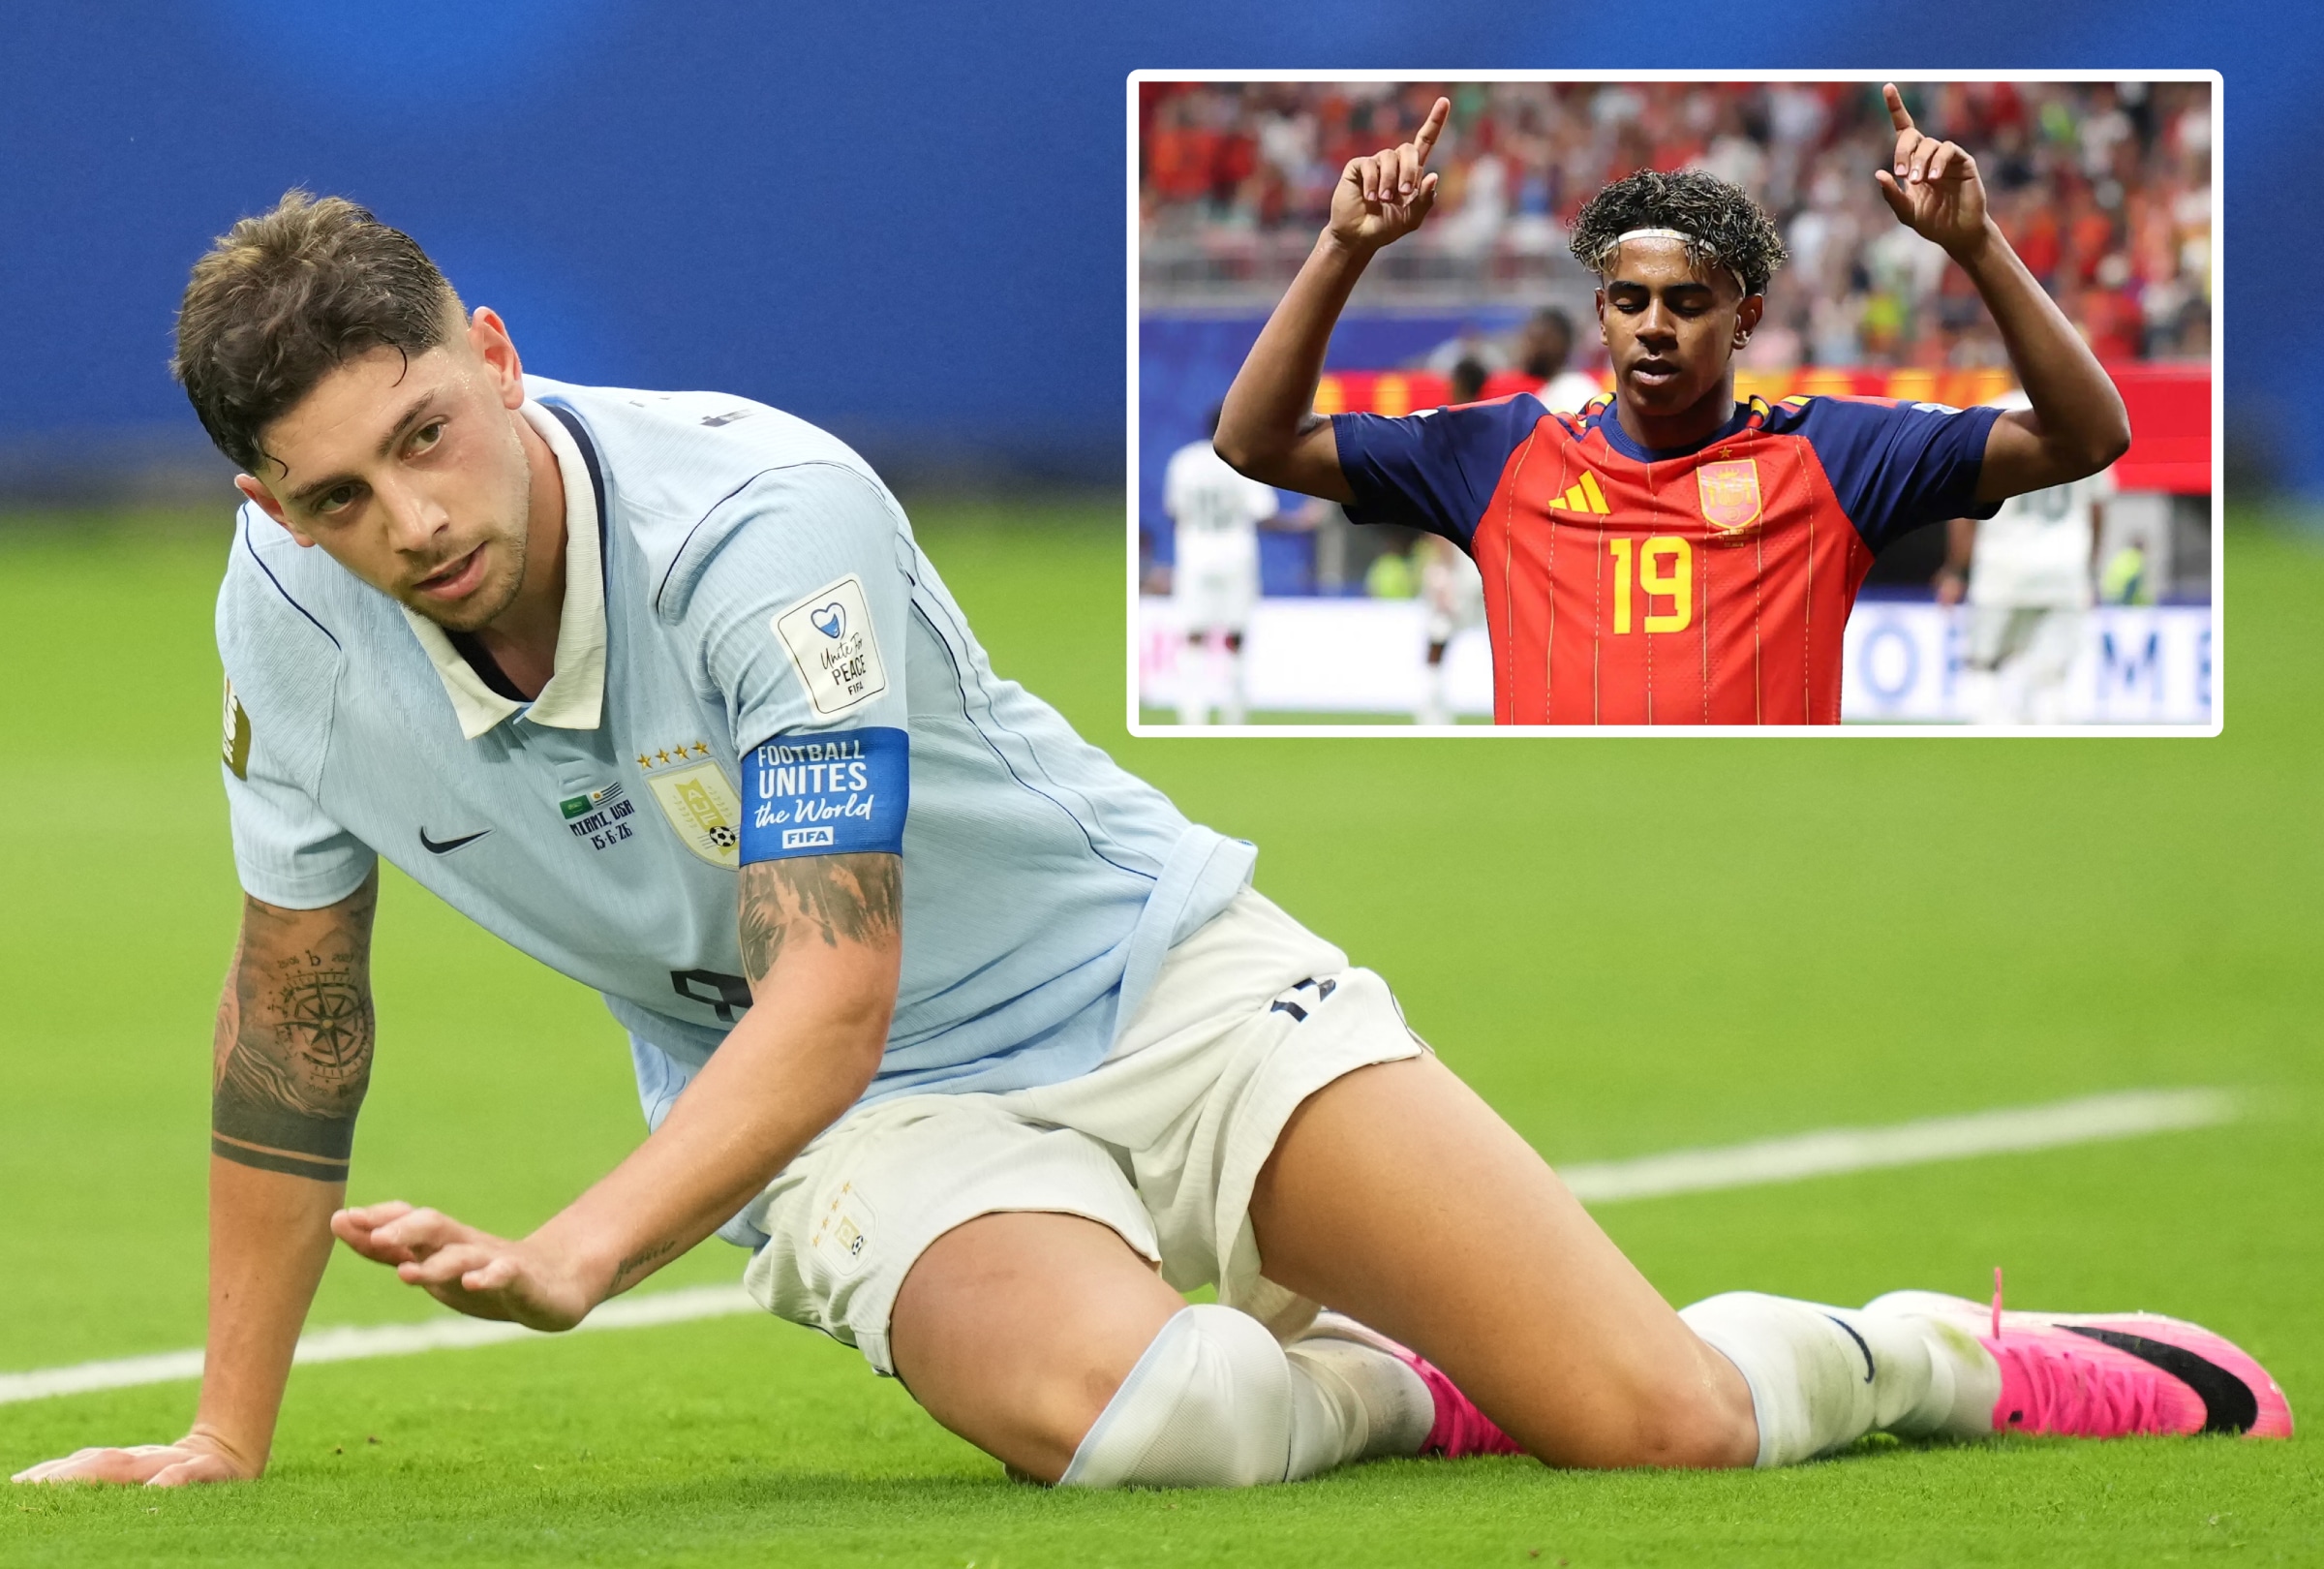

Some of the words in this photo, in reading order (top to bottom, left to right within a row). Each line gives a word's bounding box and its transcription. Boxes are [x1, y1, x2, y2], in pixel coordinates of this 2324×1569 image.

[1609, 536, 1693, 634] 19
[820, 641, 853, 670] Unite
[849, 631, 863, 654] For
[831, 654, 867, 686] PEACE
[847, 681, 864, 696] FIFA
[757, 739, 866, 768] FOOTBALL
[758, 761, 868, 799] UNITES
[568, 811, 613, 837] MIAMI,
[609, 799, 635, 820] USA
[753, 800, 790, 829] the
[793, 792, 875, 823] World
[787, 830, 830, 846] FIFA
